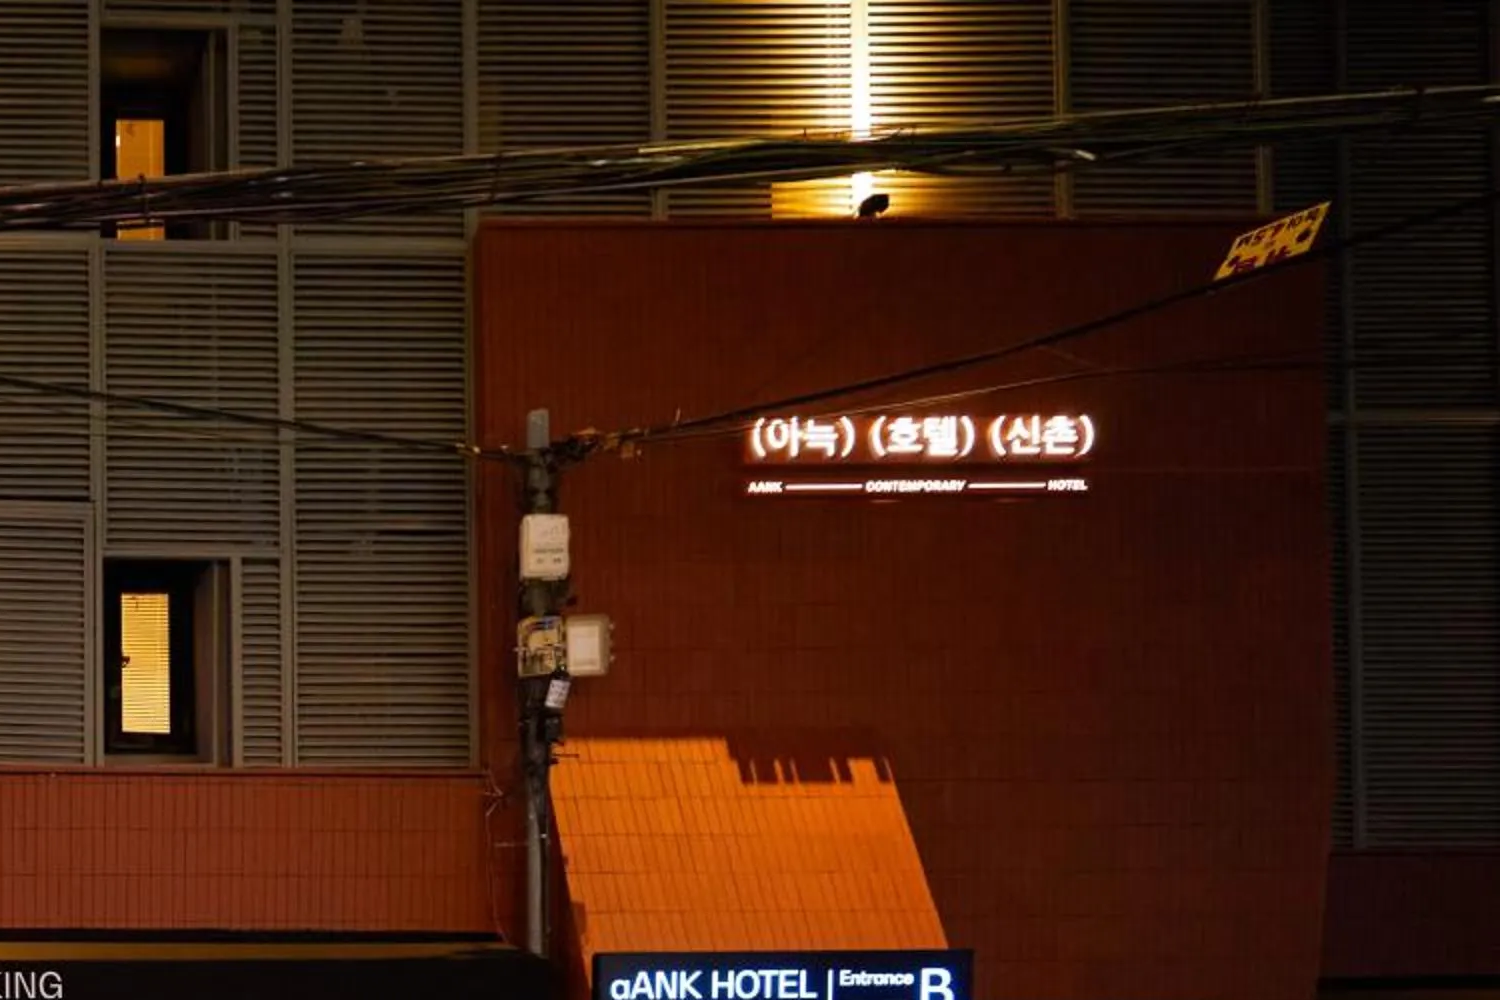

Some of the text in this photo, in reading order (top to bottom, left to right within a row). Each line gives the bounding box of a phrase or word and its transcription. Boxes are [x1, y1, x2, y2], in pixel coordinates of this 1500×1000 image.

[750, 415, 1095, 458] (아늑) (호텔) (신촌)
[865, 480, 966, 493] CONTEMPORARY
[1047, 479, 1088, 491] HOTEL
[712, 970, 818, 1000] HOTEL
[839, 970, 914, 987] Entrance
